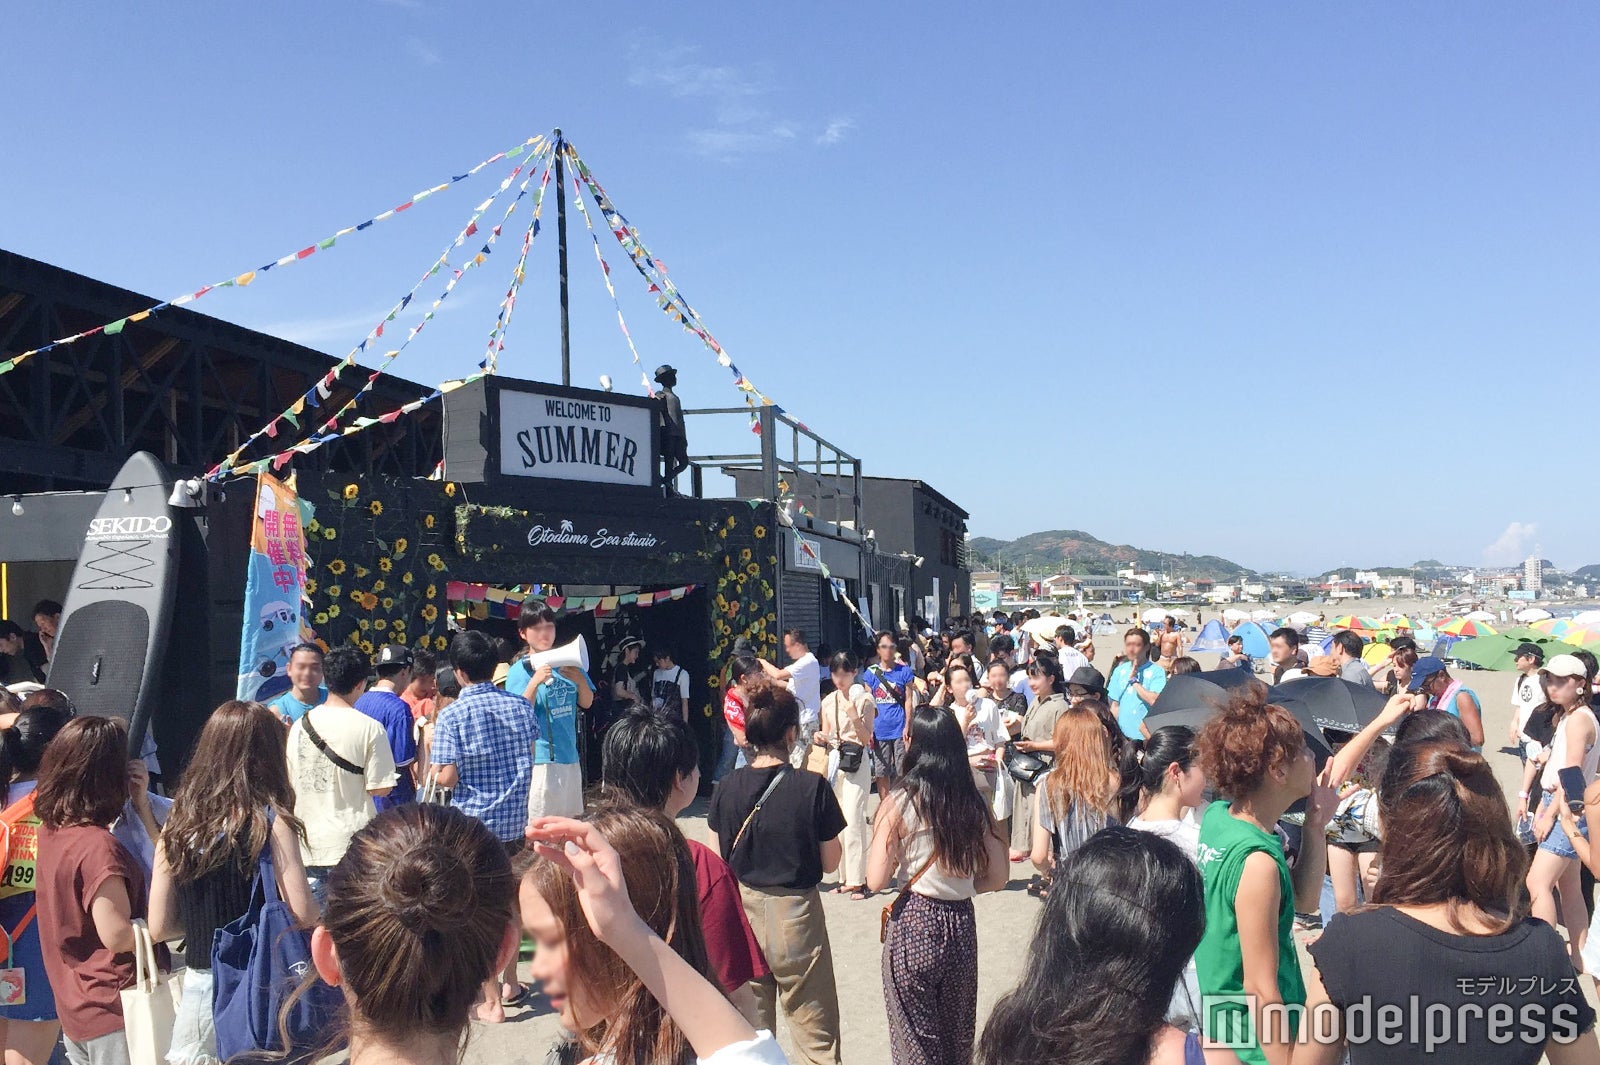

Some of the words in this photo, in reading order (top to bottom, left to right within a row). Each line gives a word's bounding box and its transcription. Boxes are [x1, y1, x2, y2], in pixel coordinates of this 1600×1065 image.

[545, 400, 596, 421] WELCOME
[599, 406, 611, 422] TO
[517, 426, 638, 477] SUMMER
[87, 516, 172, 536] SEKIDO
[528, 520, 588, 546] Otodama
[590, 528, 620, 548] Sea
[264, 510, 294, 594] 開催中
[8, 848, 35, 861] RINK
